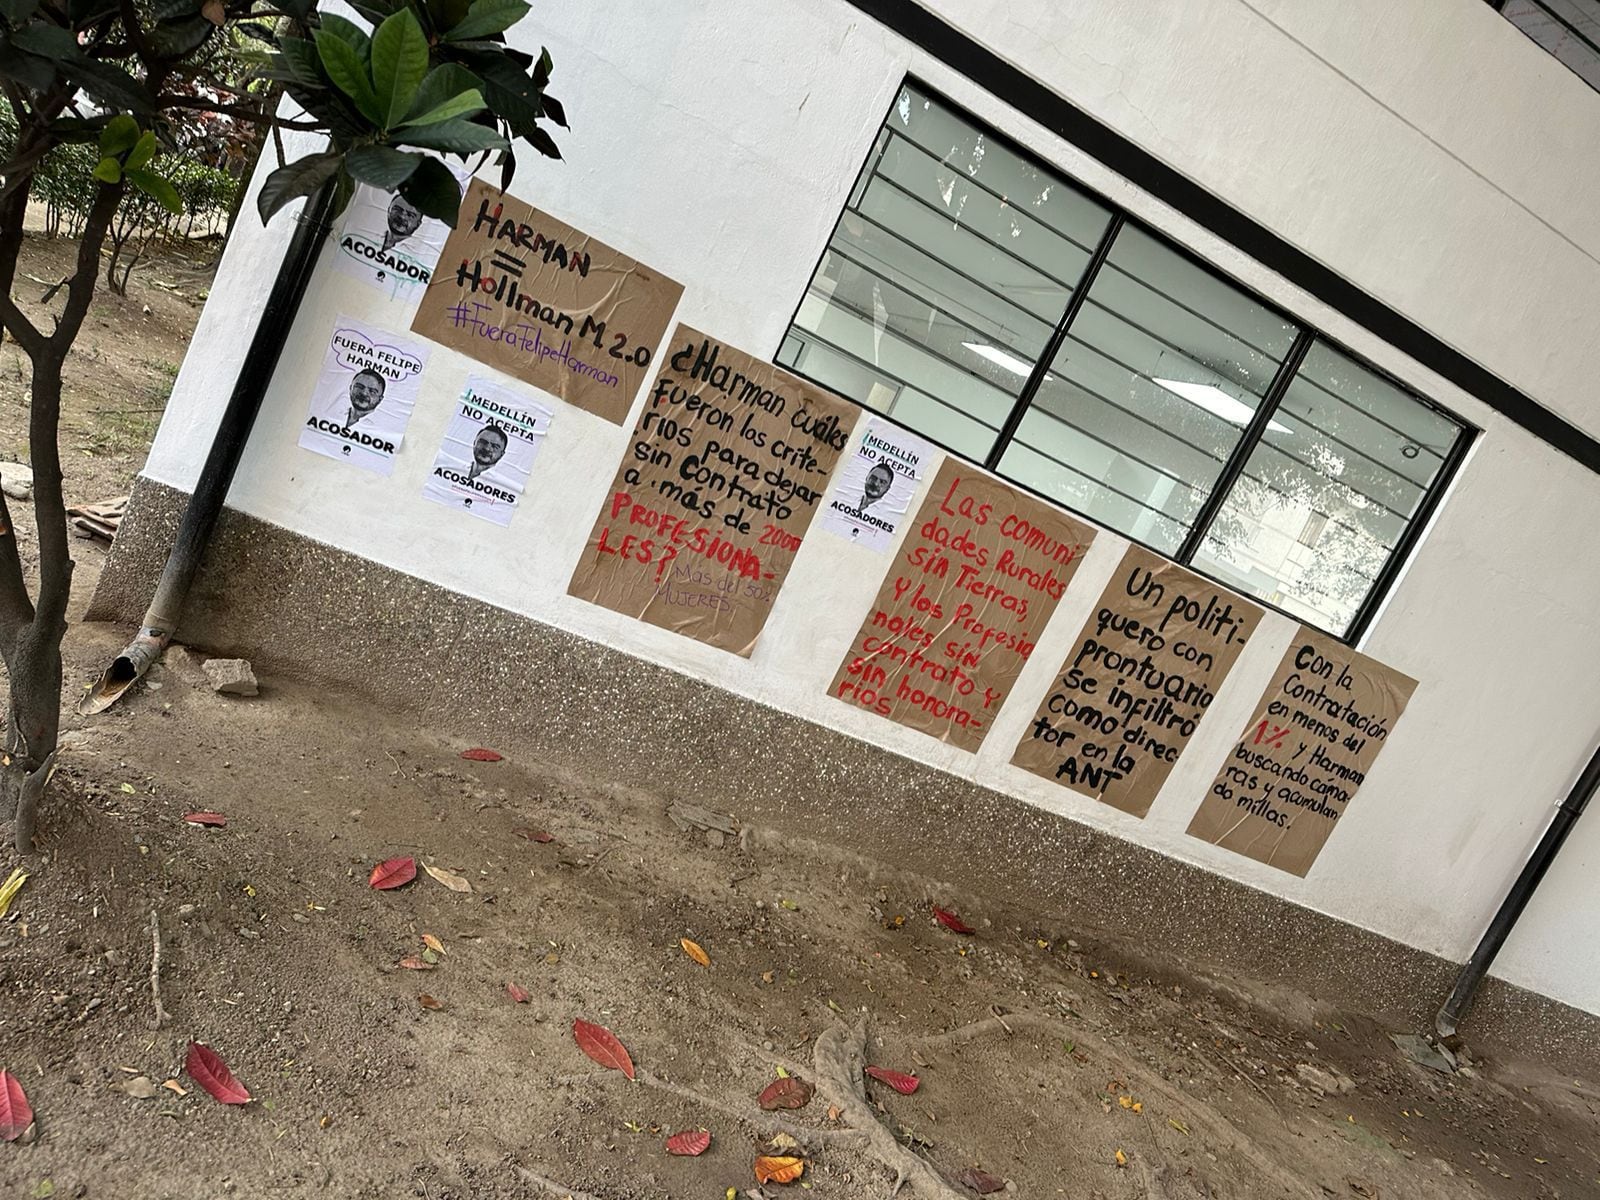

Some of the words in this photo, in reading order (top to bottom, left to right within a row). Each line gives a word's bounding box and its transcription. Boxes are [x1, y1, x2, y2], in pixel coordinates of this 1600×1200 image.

[341, 237, 430, 284] ACOSADOR
[474, 199, 591, 277] HARMAN
[456, 260, 574, 334] Hollman
[608, 333, 651, 367] 2.0
[334, 336, 374, 357] FUERA
[377, 351, 420, 373] FELIPE
[346, 354, 400, 379] HARMAN
[447, 301, 618, 388] #FueraFelipeHarman
[671, 340, 785, 417] ¿Harman
[307, 416, 395, 454] ACOSADOR
[462, 405, 483, 420] NO
[486, 417, 534, 442] ACEPTA
[652, 379, 734, 433] Fueron
[740, 414, 767, 448] los
[634, 441, 672, 468] sin
[701, 441, 760, 480] para
[764, 469, 823, 506] dejar
[860, 446, 877, 459] NO
[877, 455, 917, 479] ACEPTA
[434, 468, 516, 503] ACOSADORES
[625, 468, 641, 485] a
[659, 481, 715, 519] más
[724, 508, 751, 534] de
[940, 477, 993, 526] Las
[831, 501, 895, 533] ACOSADORES
[907, 547, 949, 578] sin
[921, 517, 989, 567] dades
[995, 550, 1067, 600] Rurales
[718, 574, 740, 594] del
[910, 584, 943, 619] los
[1126, 567, 1164, 607] Un
[1159, 595, 1246, 644] politi-
[1097, 608, 1165, 651] quero
[1173, 642, 1212, 672] con
[863, 637, 975, 695] contrato
[1074, 639, 1214, 709] prontuario
[1294, 645, 1334, 681] Con
[1336, 664, 1353, 691] la
[838, 680, 892, 716] rios
[847, 657, 886, 689] sin
[896, 674, 983, 729] honora-
[1048, 694, 1118, 734] como
[1063, 669, 1098, 694] se
[1107, 679, 1200, 737] infiltró
[1283, 674, 1388, 741] Contratación
[1034, 717, 1076, 748] tor
[1081, 743, 1107, 762] en
[1112, 744, 1135, 774] la
[1268, 701, 1288, 717] en
[1292, 710, 1339, 742] menos
[1343, 733, 1366, 755] del
[1055, 757, 1123, 794] ANT
[1235, 742, 1308, 786] buscando
[1253, 719, 1290, 748] 1%
[1309, 744, 1365, 786] Harman
[1213, 782, 1233, 799] do
[1226, 766, 1257, 790] ras
[1259, 783, 1274, 802] y
